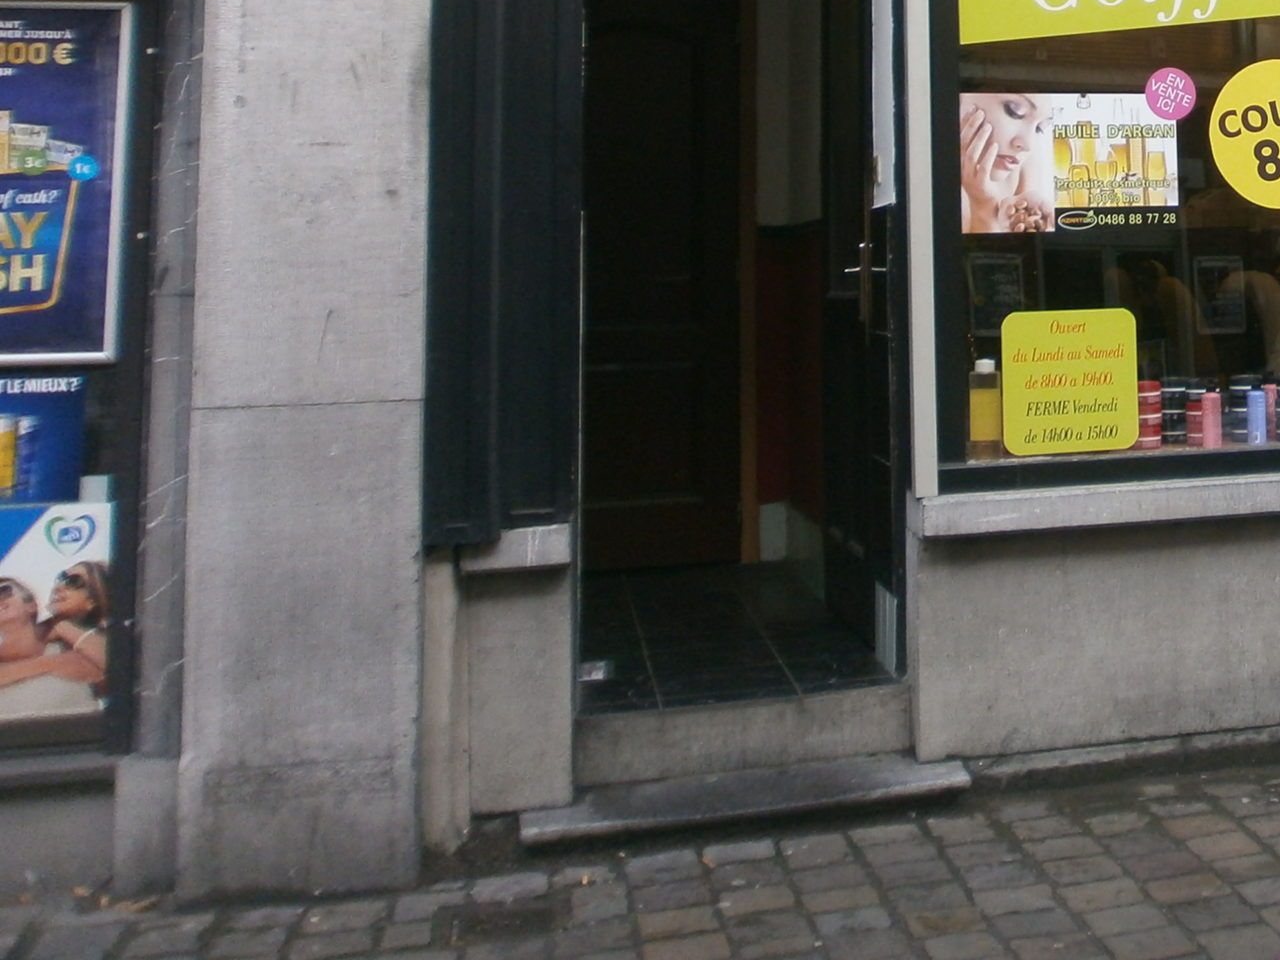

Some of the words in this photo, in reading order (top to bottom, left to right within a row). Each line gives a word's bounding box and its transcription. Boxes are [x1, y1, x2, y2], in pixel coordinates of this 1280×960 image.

[1166, 73, 1185, 90] EN
[1152, 79, 1192, 107] VENTE
[1156, 98, 1176, 113] ICI
[1054, 124, 1100, 139] HUILE
[1107, 124, 1175, 139] D'ARGAN
[1089, 192, 1120, 203] 100%
[1122, 192, 1141, 203] bio
[1098, 214, 1125, 225] 0486
[1129, 213, 1142, 224] 88
[1146, 213, 1159, 224] 77
[1163, 213, 1177, 224] 28
[1050, 320, 1086, 334] Ouvert
[1012, 348, 1028, 363] du
[1032, 347, 1064, 362] Lundi
[1067, 350, 1081, 361] au
[1085, 344, 1124, 361] Samedi
[1025, 375, 1038, 389] de
[1040, 373, 1067, 388] 8h00
[1026, 400, 1070, 417] FERME
[1072, 397, 1118, 414] Vendredi
[1024, 428, 1037, 443] de
[1042, 427, 1073, 443] 14h00
[1087, 425, 1118, 440] 15h00
